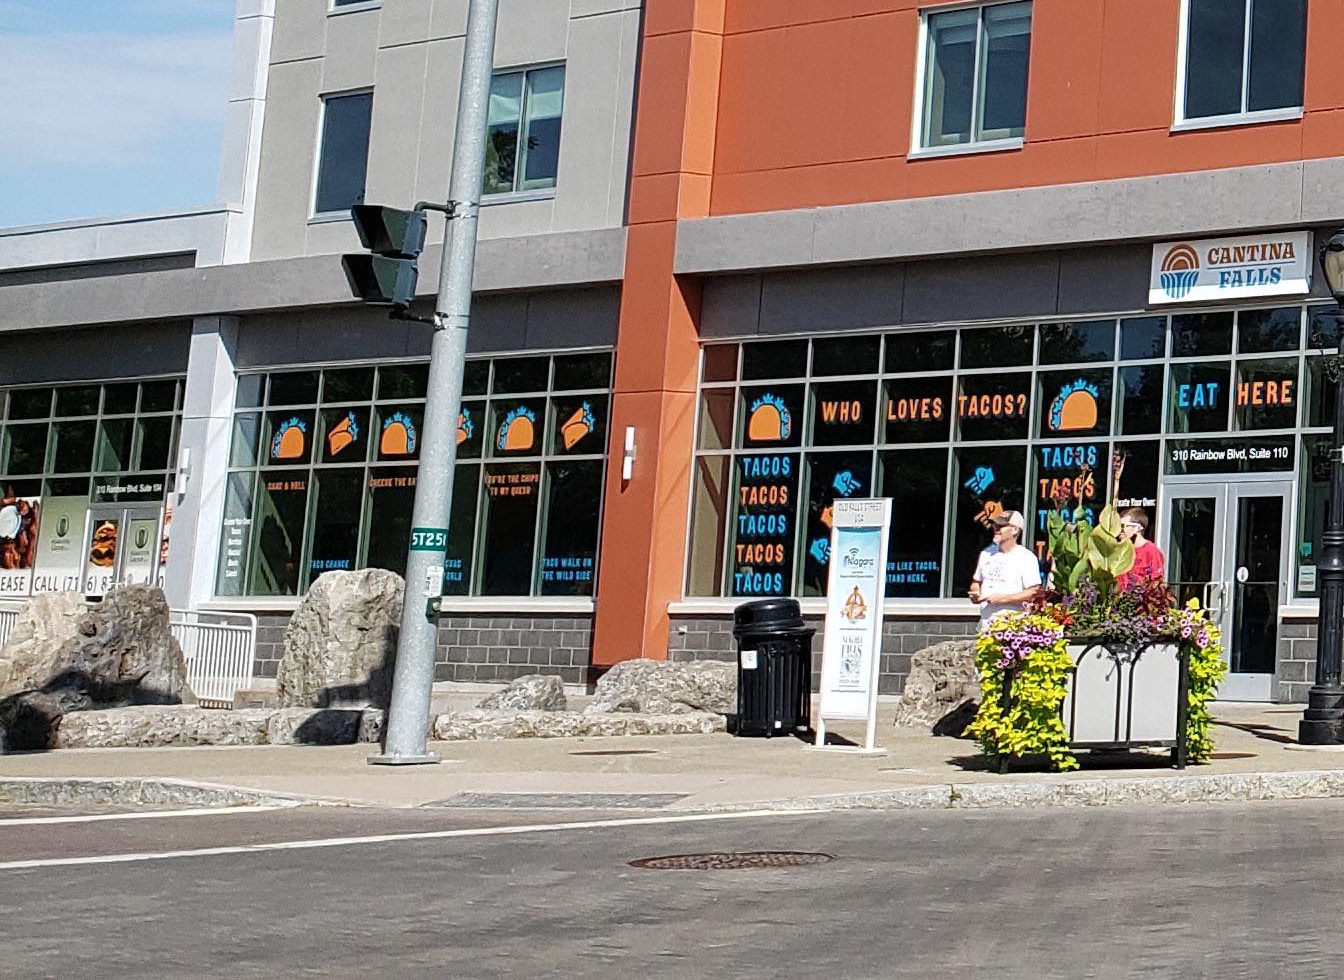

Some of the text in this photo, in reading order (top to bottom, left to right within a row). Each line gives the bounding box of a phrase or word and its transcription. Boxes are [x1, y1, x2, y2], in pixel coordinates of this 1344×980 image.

[1207, 242, 1295, 265] CANTINA
[1219, 267, 1282, 289] FALLS
[1178, 380, 1293, 407] EAT HERE
[821, 393, 1027, 422] WHO LOVES TACOS?
[1041, 445, 1097, 468] TACOS
[1172, 447, 1289, 461] 310 Rainbow Blvd, Suite 110
[743, 456, 791, 477] TACOS
[740, 485, 788, 505] TACOS
[738, 514, 786, 535] TACOS
[561, 558, 580, 568] WALK
[736, 543, 784, 564] TACOS
[897, 562, 913, 571] LIKE
[34, 576, 58, 591] CALL
[735, 572, 783, 593] TACOS
[887, 573, 905, 583] TAND
